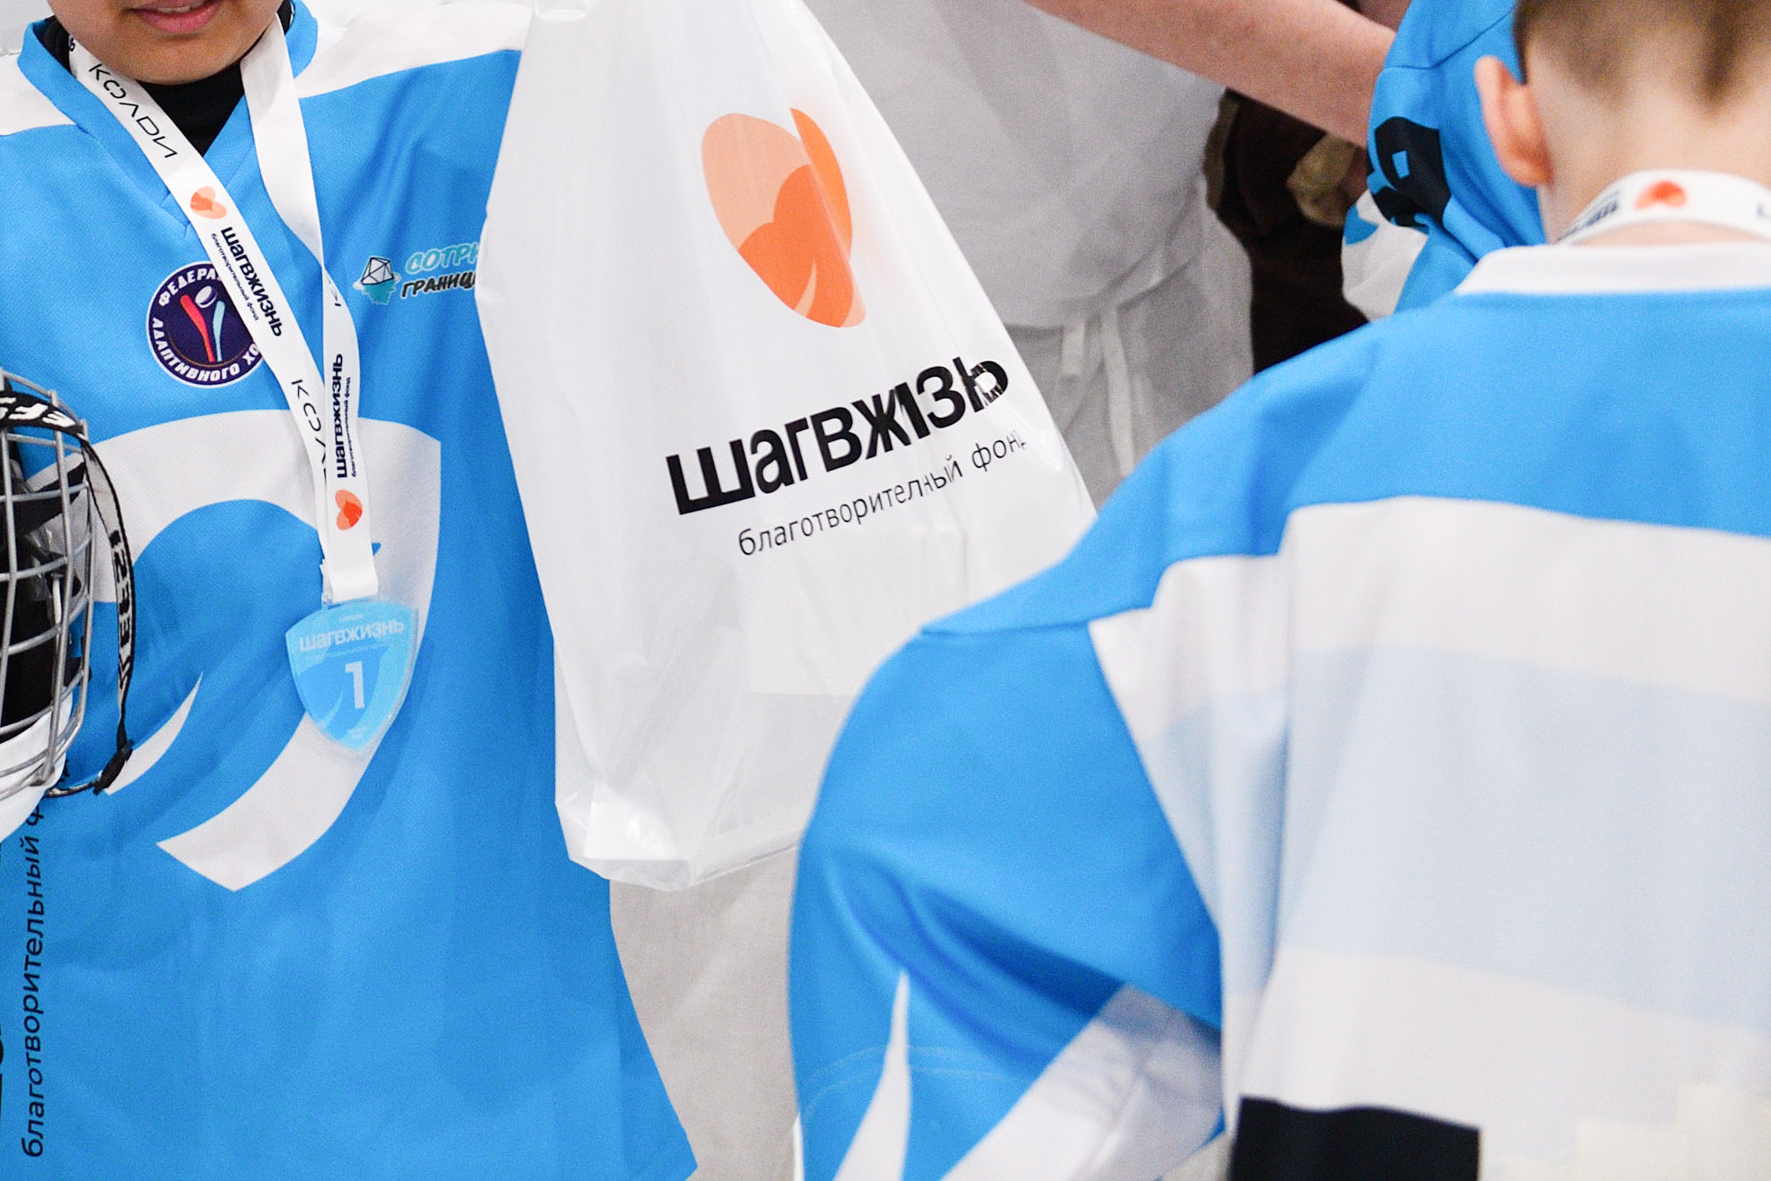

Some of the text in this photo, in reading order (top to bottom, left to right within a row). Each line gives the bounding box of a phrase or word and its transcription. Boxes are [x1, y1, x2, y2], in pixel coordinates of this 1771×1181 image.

[158, 268, 221, 307] ФЕДЕРА
[401, 271, 476, 298] ГРАНИЦ
[152, 317, 240, 382] АДАПТИВНОГО
[345, 660, 365, 710] 1
[21, 836, 45, 1158] благотворительный
